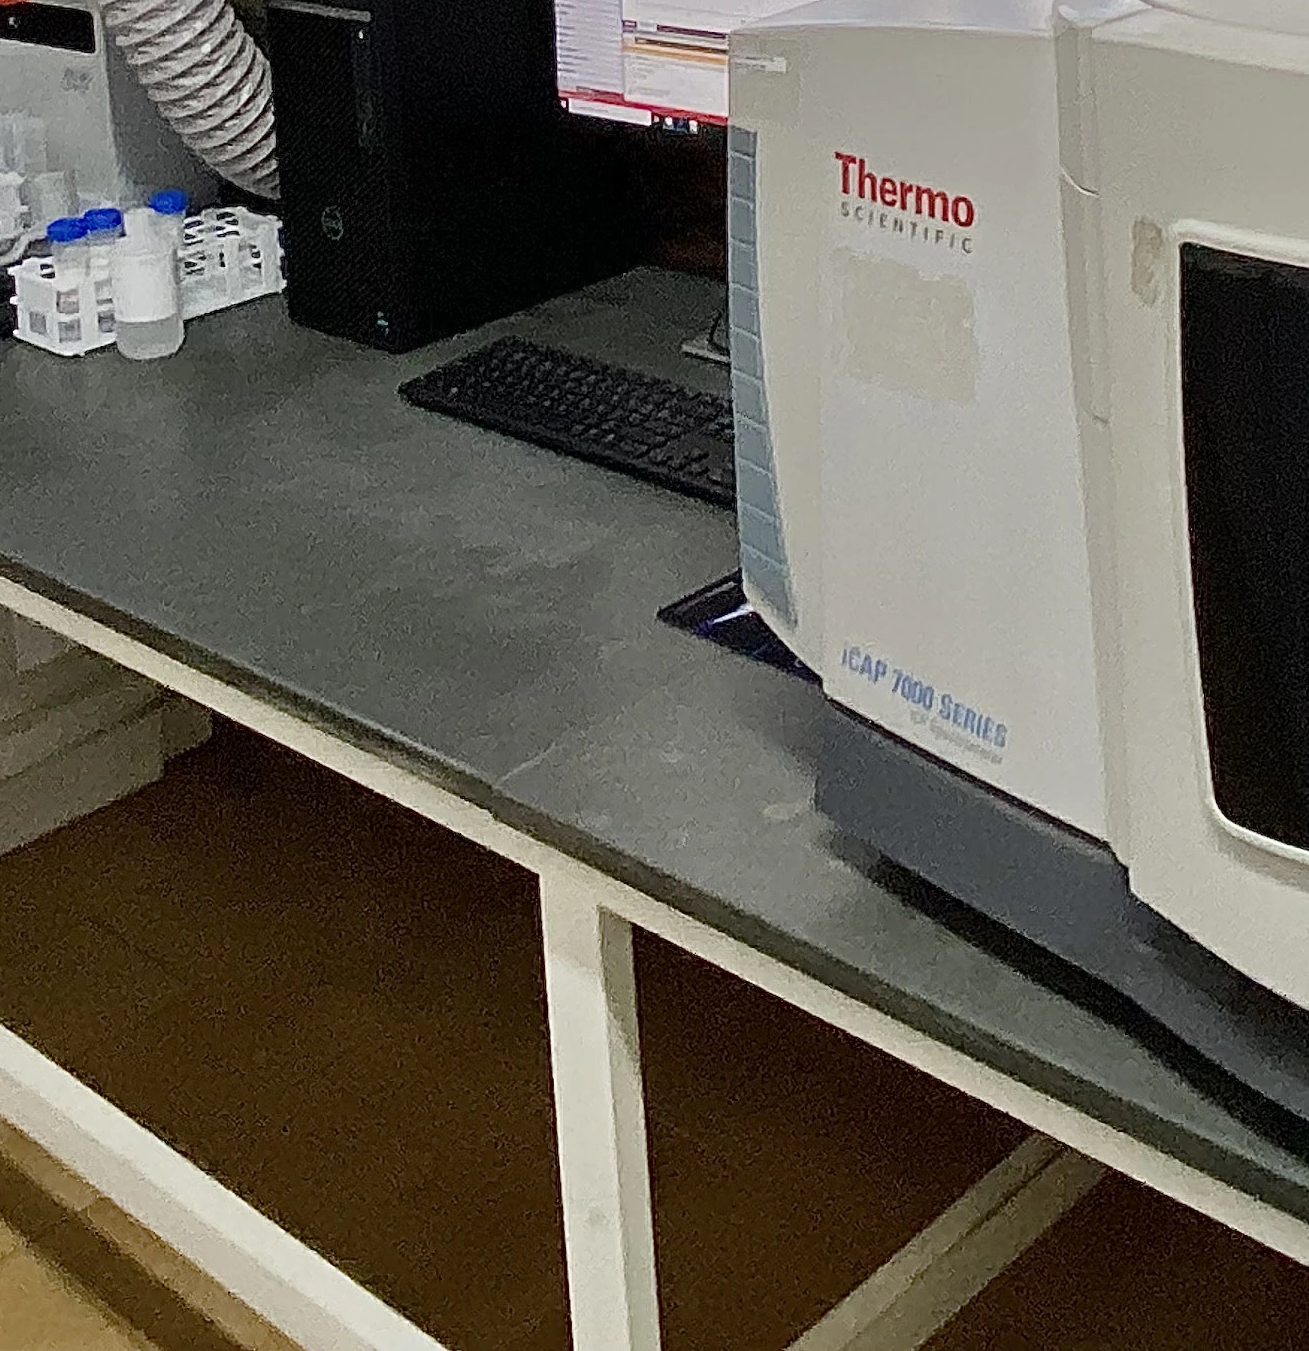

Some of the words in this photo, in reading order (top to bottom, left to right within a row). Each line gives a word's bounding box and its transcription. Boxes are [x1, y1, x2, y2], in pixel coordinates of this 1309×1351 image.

[834, 151, 975, 227] Thermo
[840, 201, 973, 254] SCIENTIFIC
[891, 667, 935, 711] 7000
[939, 693, 1008, 748] SERIES
